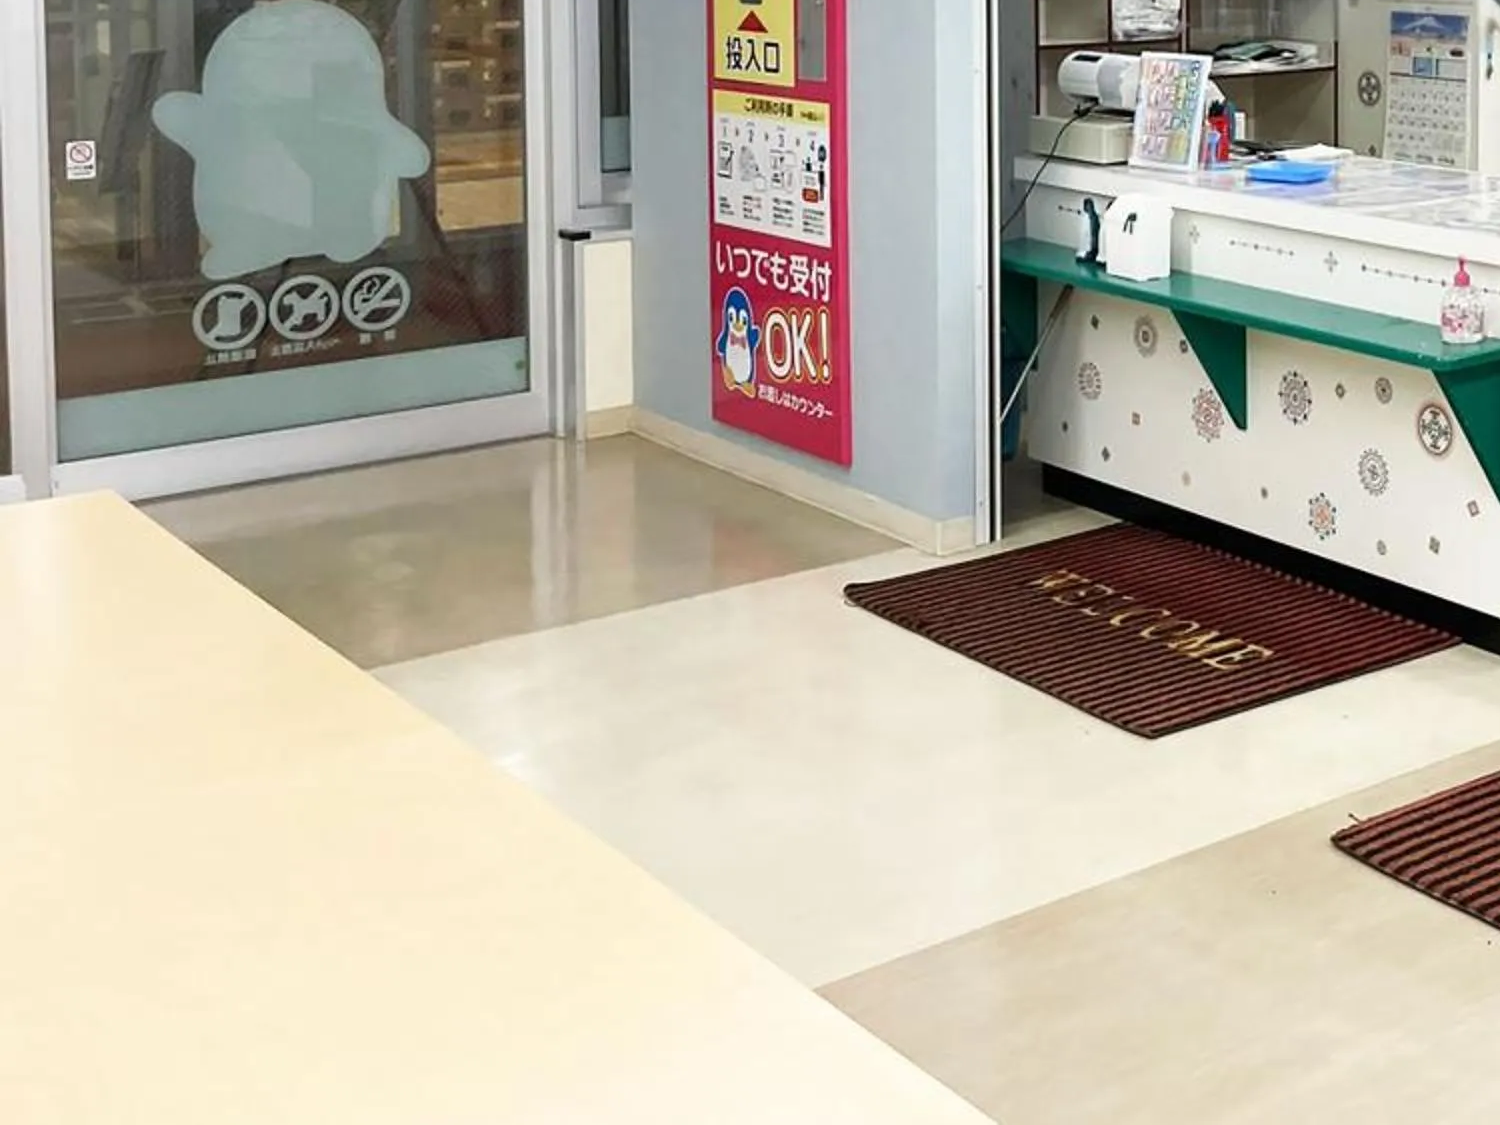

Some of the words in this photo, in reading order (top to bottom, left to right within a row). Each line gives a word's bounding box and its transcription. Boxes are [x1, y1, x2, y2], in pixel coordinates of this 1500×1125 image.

[726, 36, 781, 73] 投入口
[715, 240, 834, 303] いつでも受付
[765, 310, 831, 381] OK!
[1028, 565, 1274, 673] WELCOME
